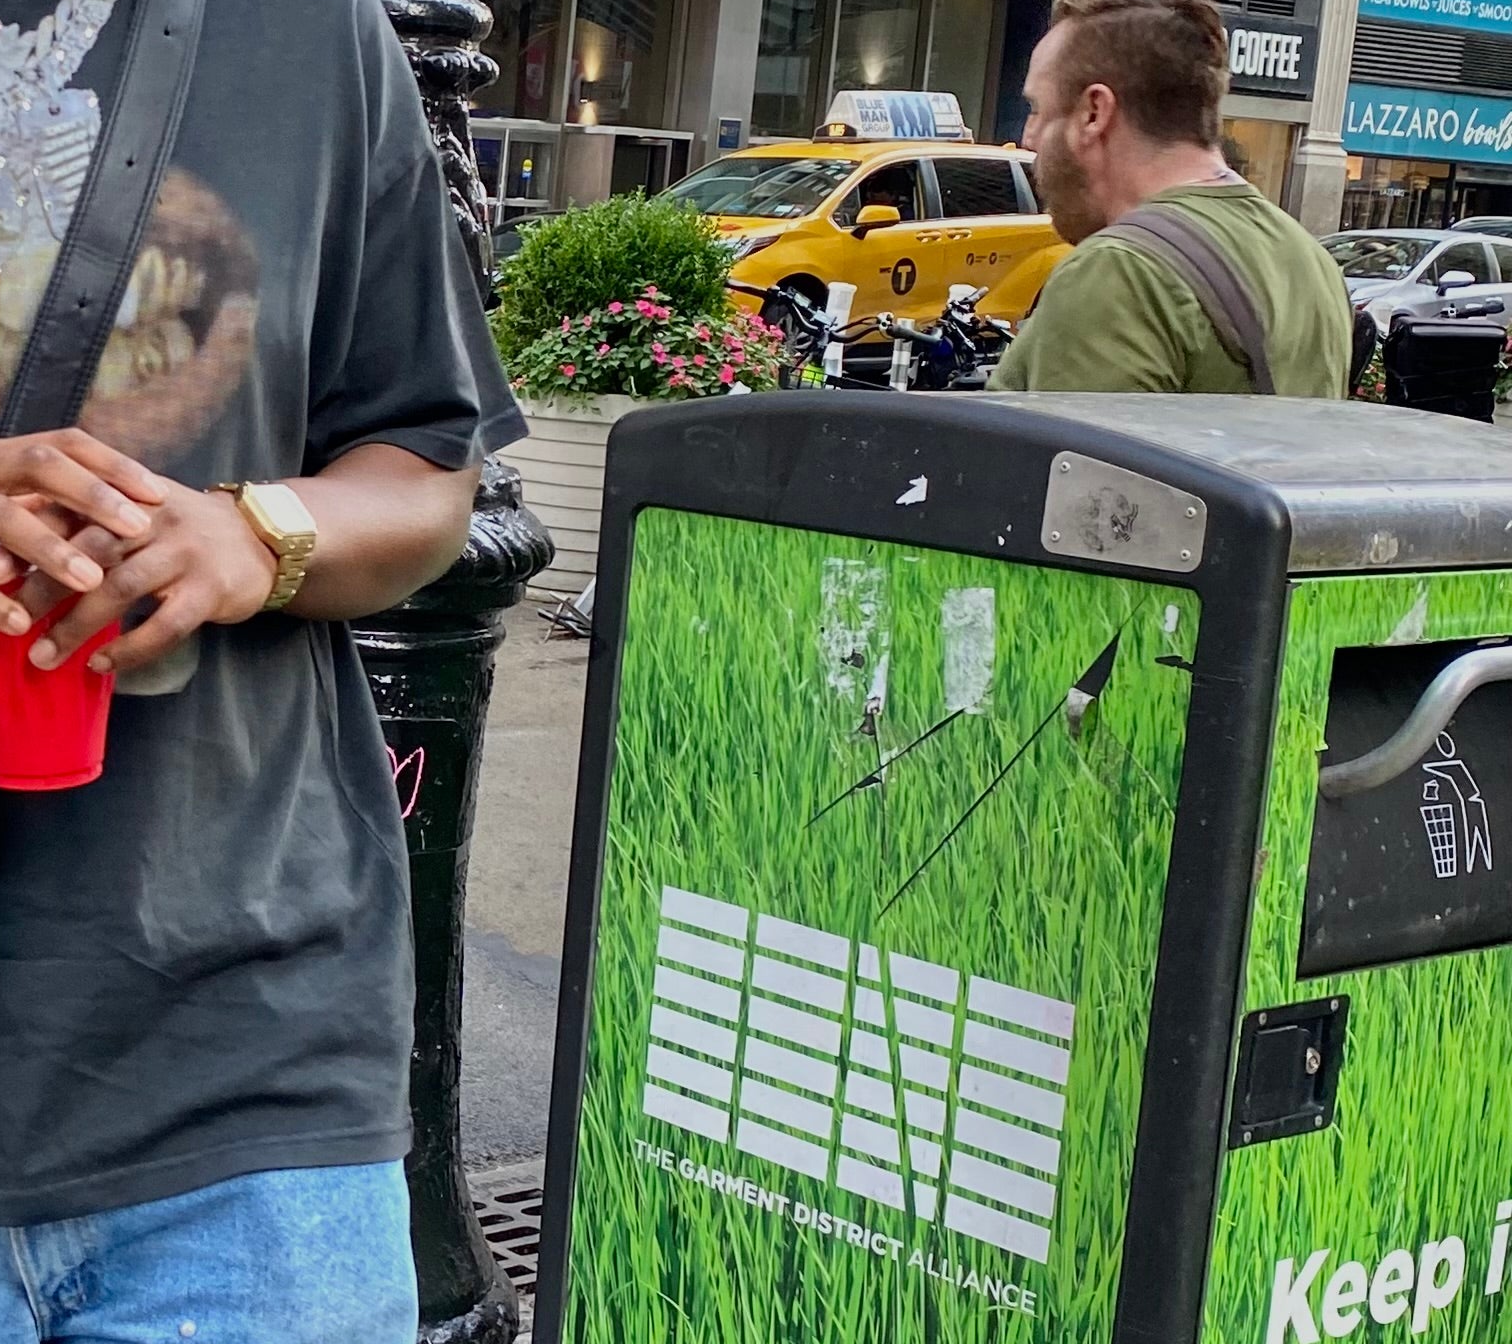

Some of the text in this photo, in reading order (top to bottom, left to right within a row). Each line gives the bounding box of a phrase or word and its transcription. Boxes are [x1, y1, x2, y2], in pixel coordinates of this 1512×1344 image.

[1230, 29, 1303, 80] COFFEE
[856, 98, 886, 110] BLUE
[859, 111, 889, 123] MAN
[861, 124, 891, 133] GROUP
[1347, 101, 1460, 142] LAZZARO
[897, 266, 912, 291] T
[634, 1139, 1038, 1316] THE GARMENT DISTRICT ALLIANCE
[1485, 1200, 1512, 1296] i
